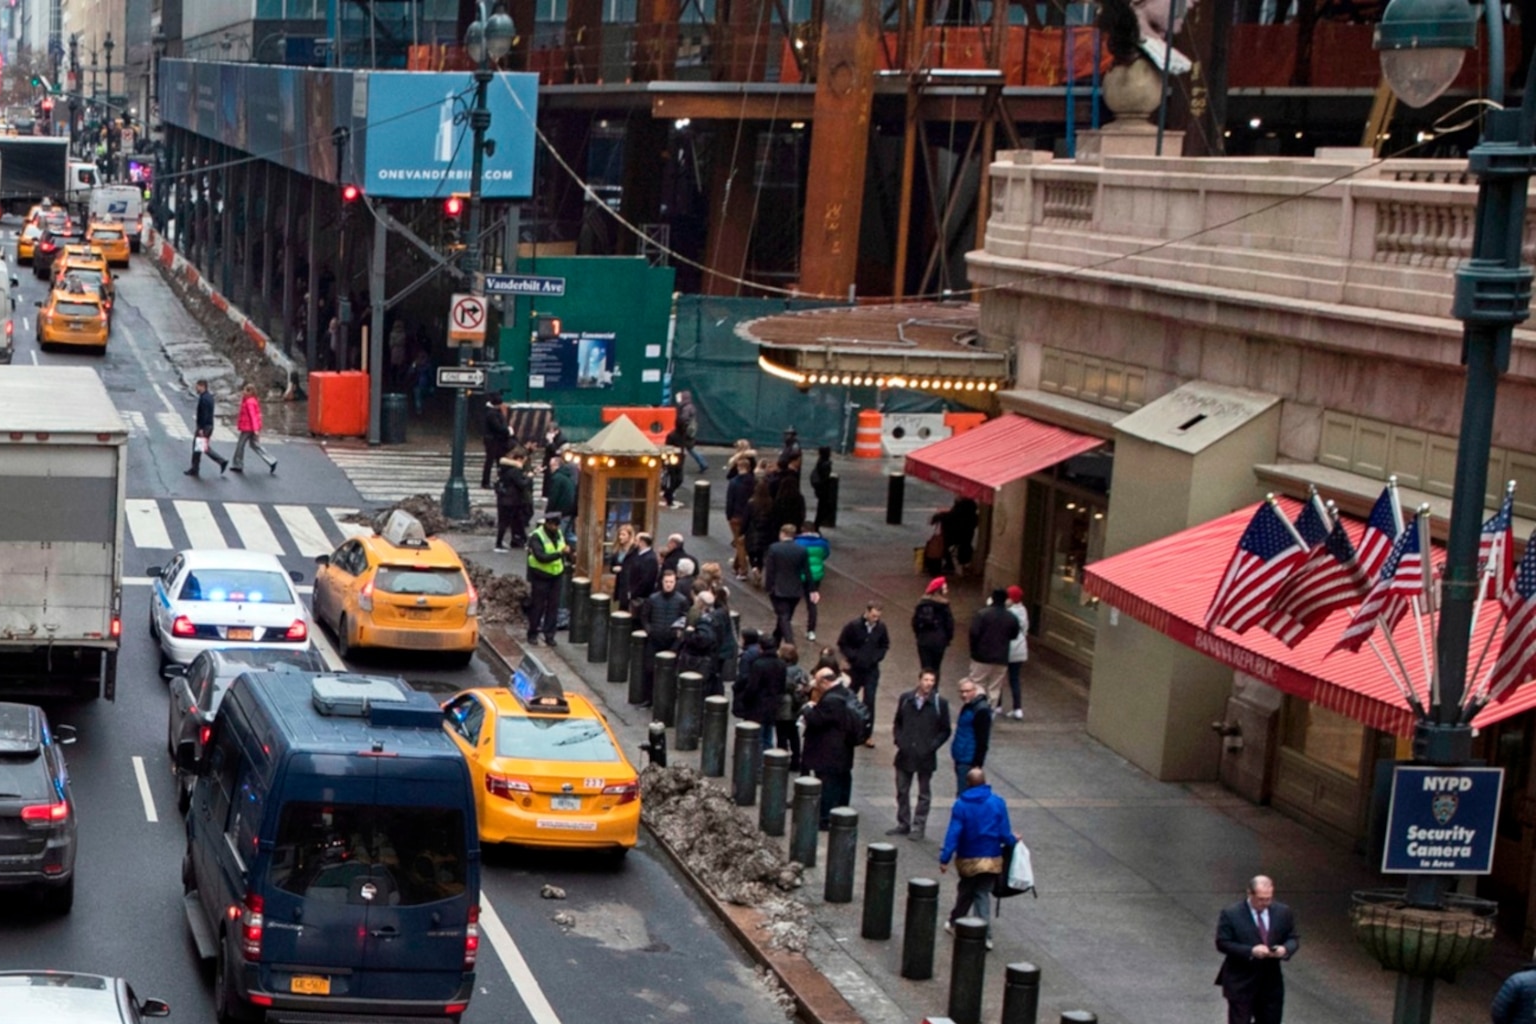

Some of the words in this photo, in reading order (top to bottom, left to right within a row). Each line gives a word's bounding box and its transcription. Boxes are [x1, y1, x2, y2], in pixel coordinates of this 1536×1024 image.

[378, 168, 513, 180] ONEVANDERBI.COM
[487, 278, 540, 291] Vanderbilt
[542, 281, 562, 292] Ave
[1195, 629, 1233, 662] BANANA
[1232, 646, 1281, 682] REPUBLIC
[1423, 776, 1473, 792] NYPD
[1407, 825, 1476, 844] Security
[1406, 842, 1472, 857] Camera
